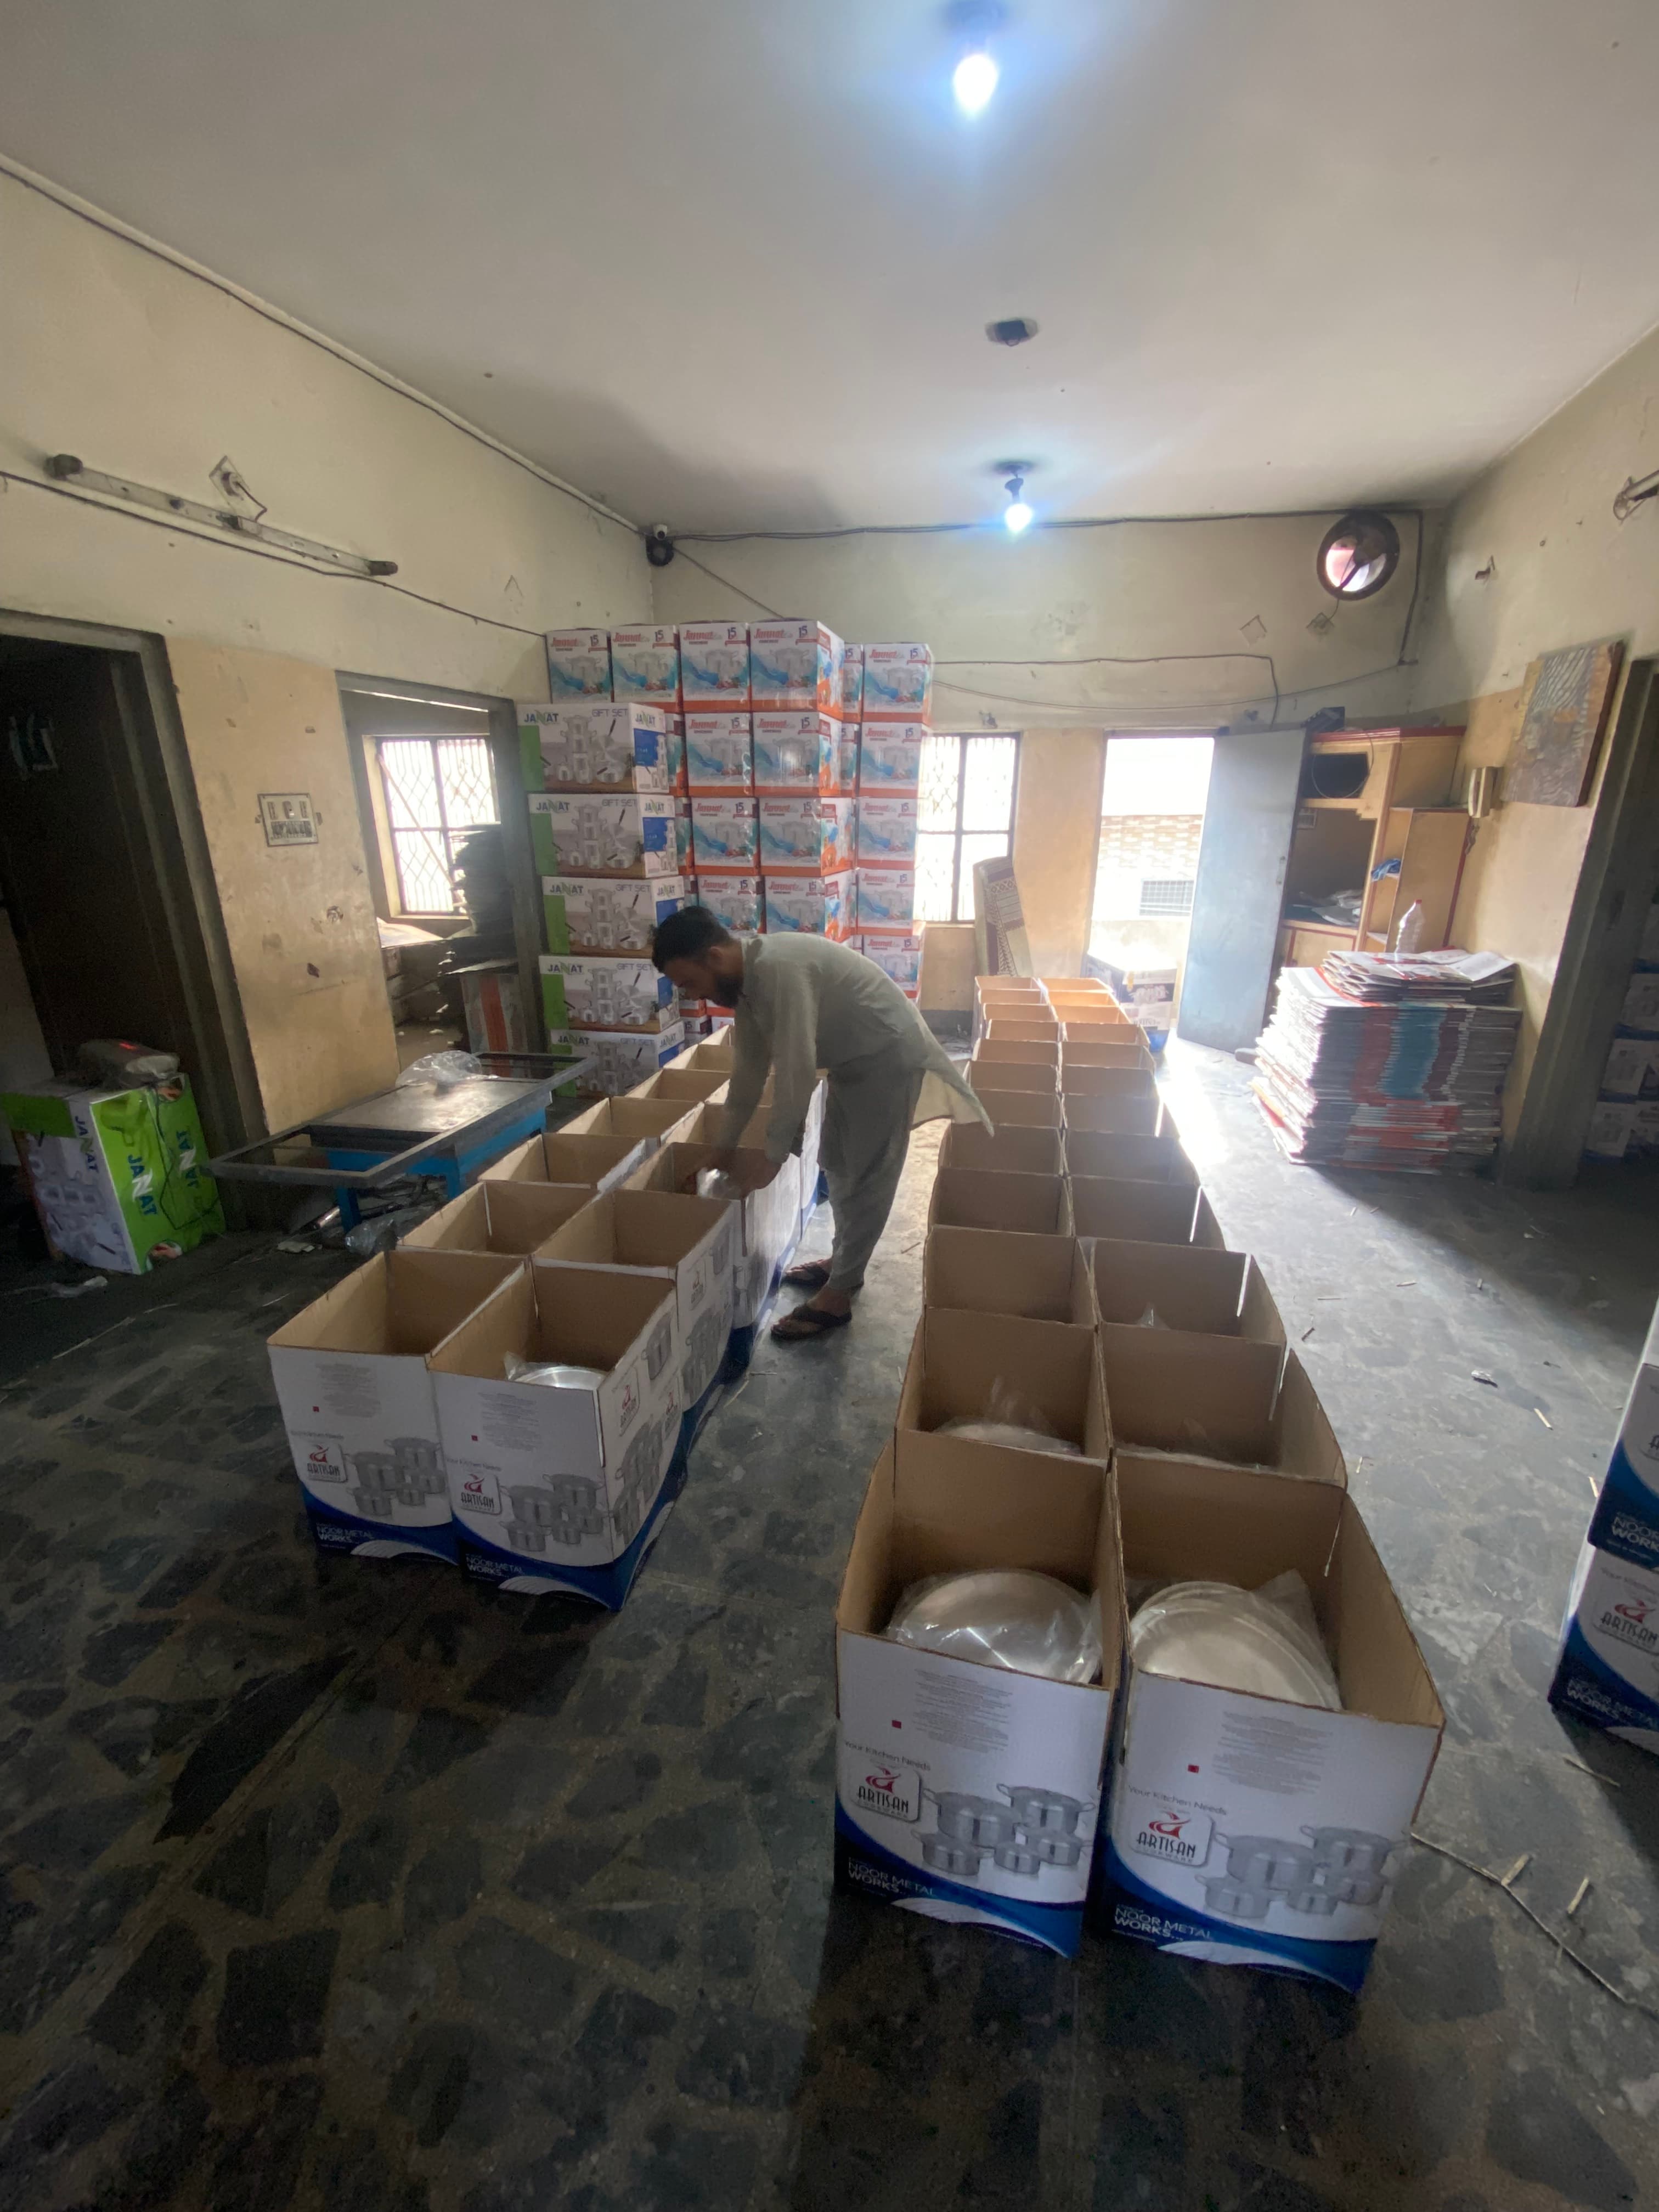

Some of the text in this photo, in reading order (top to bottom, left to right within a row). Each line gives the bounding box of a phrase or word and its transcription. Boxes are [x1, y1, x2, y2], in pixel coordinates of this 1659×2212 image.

[655, 630, 664, 641] 15
[727, 627, 736, 640] 15
[799, 625, 808, 638] 15
[590, 635, 599, 646] 15
[910, 648, 918, 659] 15
[612, 709, 628, 717] SET
[801, 717, 810, 729] 15
[905, 727, 913, 738] 15
[735, 802, 744, 813] 15
[803, 802, 812, 812] 15
[740, 880, 748, 889] 15
[461, 1492, 494, 1508] ARTISAN
[1601, 1611, 1659, 1645] ARTISAN
[857, 1786, 909, 1813] ARTISAN
[1128, 1785, 1227, 1815] Your Kitchen Needs
[1137, 1831, 1196, 1858] ARTISAN
[849, 1861, 888, 1881] NOOR
[892, 1876, 938, 1897] METAL
[1115, 1908, 1161, 1926] NOOR
[1165, 1920, 1214, 1940] METAL
